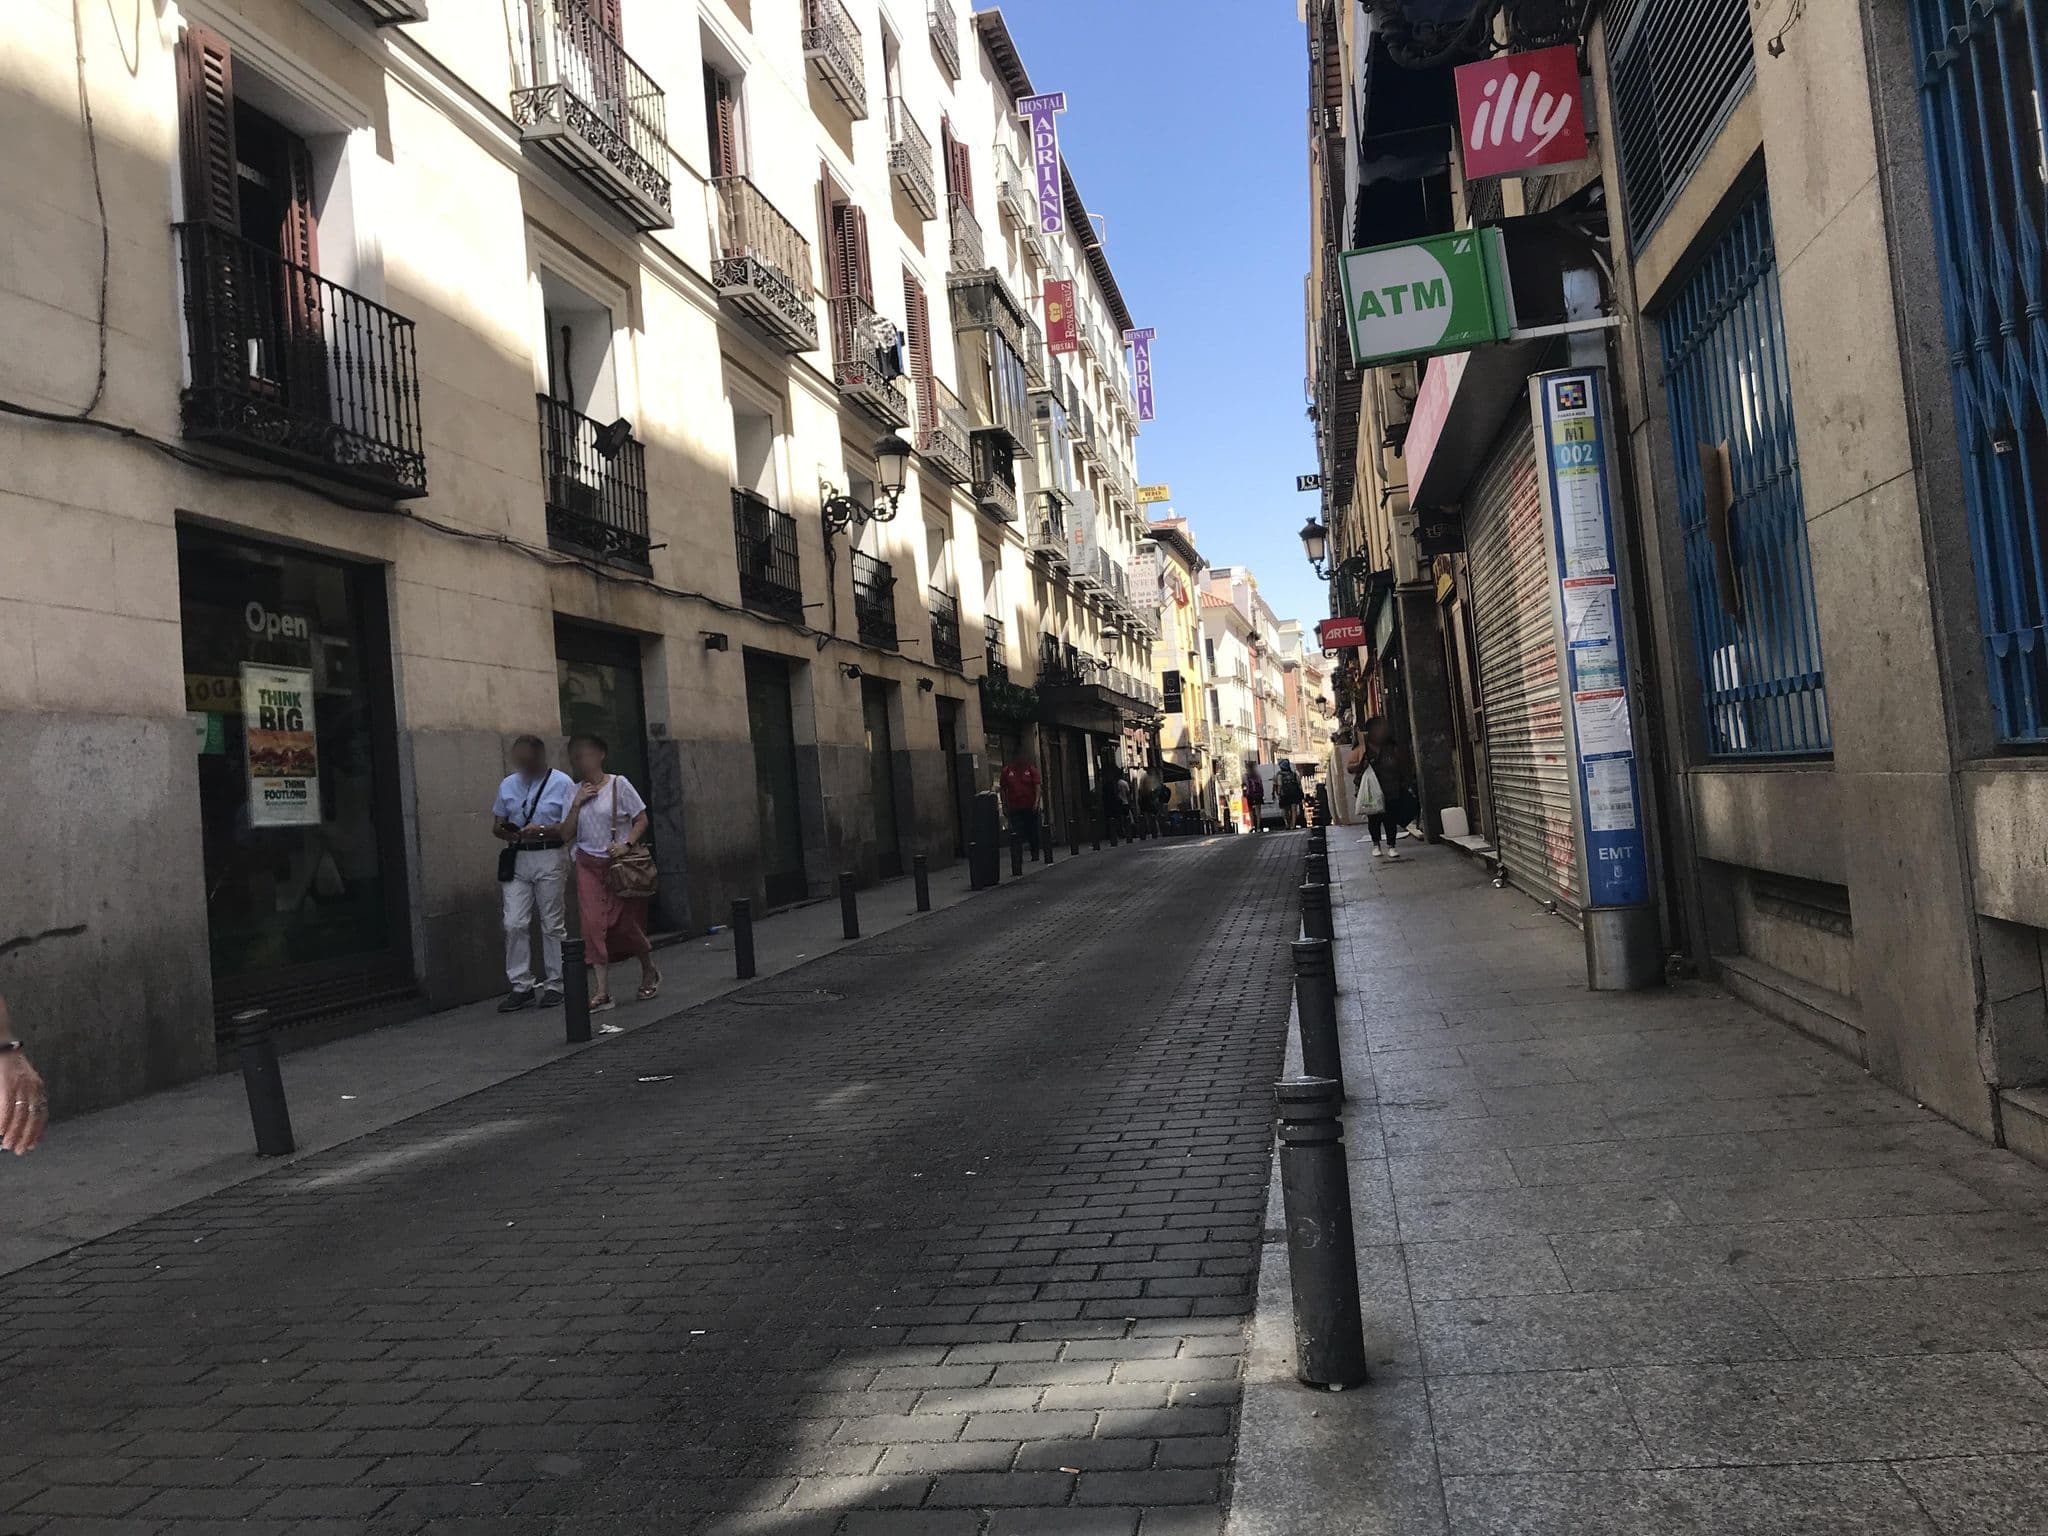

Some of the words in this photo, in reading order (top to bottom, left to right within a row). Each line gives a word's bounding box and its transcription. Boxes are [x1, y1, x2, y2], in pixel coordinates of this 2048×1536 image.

[1020, 96, 1062, 113] HOSTAL
[1470, 70, 1572, 157] illy
[1035, 116, 1060, 231] ADRIANO
[1358, 278, 1446, 321] ATM
[1125, 330, 1153, 340] HOSTAL
[1051, 342, 1074, 352] HOSTAL
[1136, 344, 1152, 418] ADRIA
[1565, 426, 1584, 442] M1
[1561, 444, 1593, 464] 002
[246, 601, 308, 642] Open
[1325, 625, 1363, 640] ARTES
[258, 688, 303, 707] THINK
[259, 705, 304, 732] BIG
[283, 779, 306, 789] THINK
[1599, 847, 1633, 860] EMT
